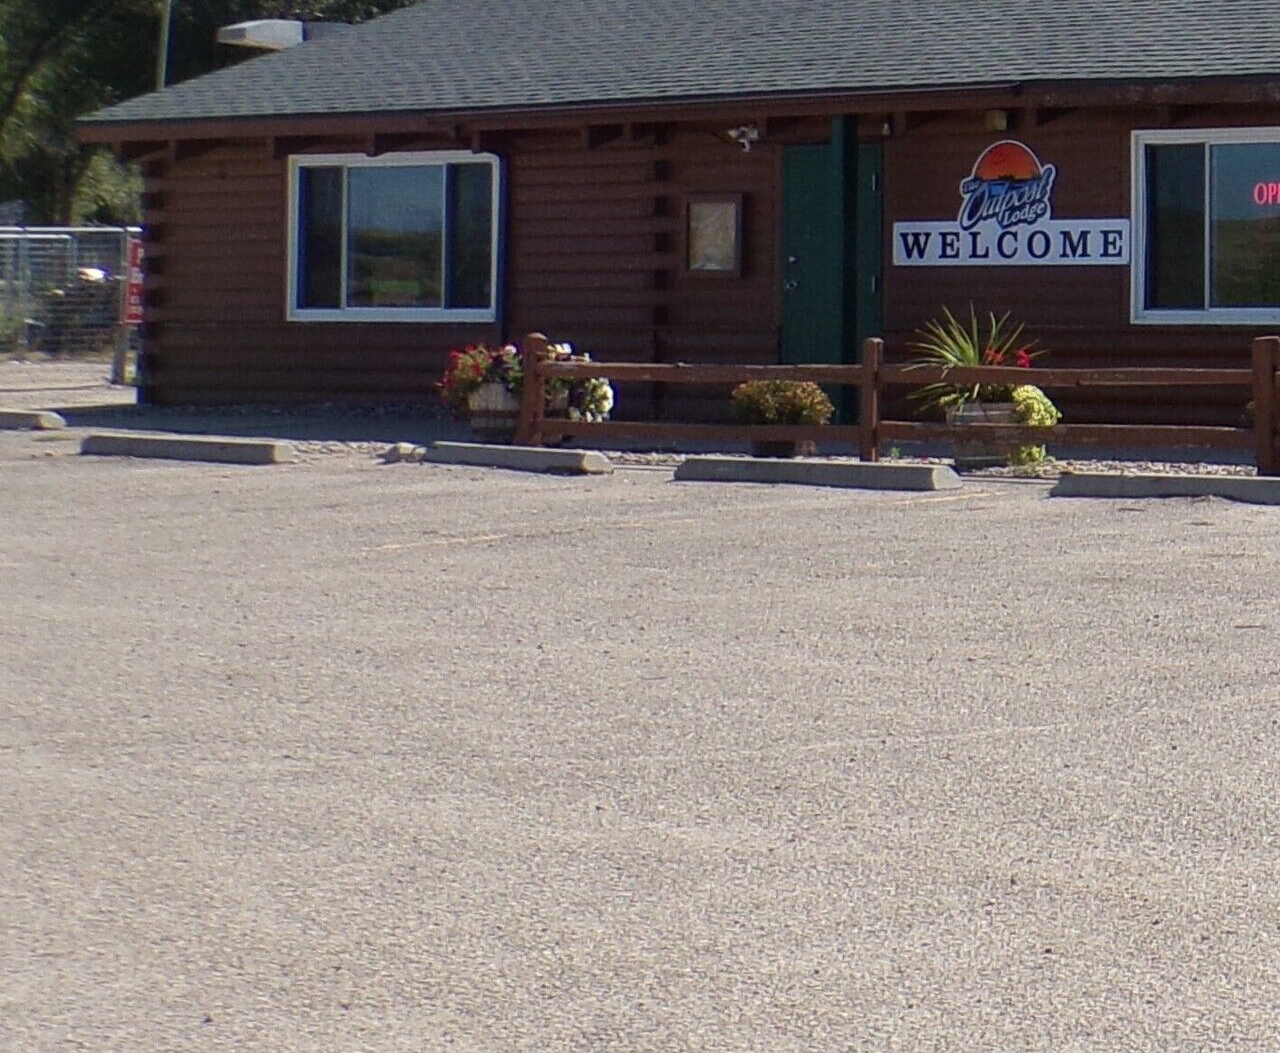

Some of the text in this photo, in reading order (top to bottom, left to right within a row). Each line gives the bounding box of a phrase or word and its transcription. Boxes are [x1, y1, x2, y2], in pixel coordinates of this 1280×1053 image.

[961, 167, 1053, 228] Outpost
[1003, 200, 1046, 226] Lodge
[900, 229, 1123, 259] WELCOME
